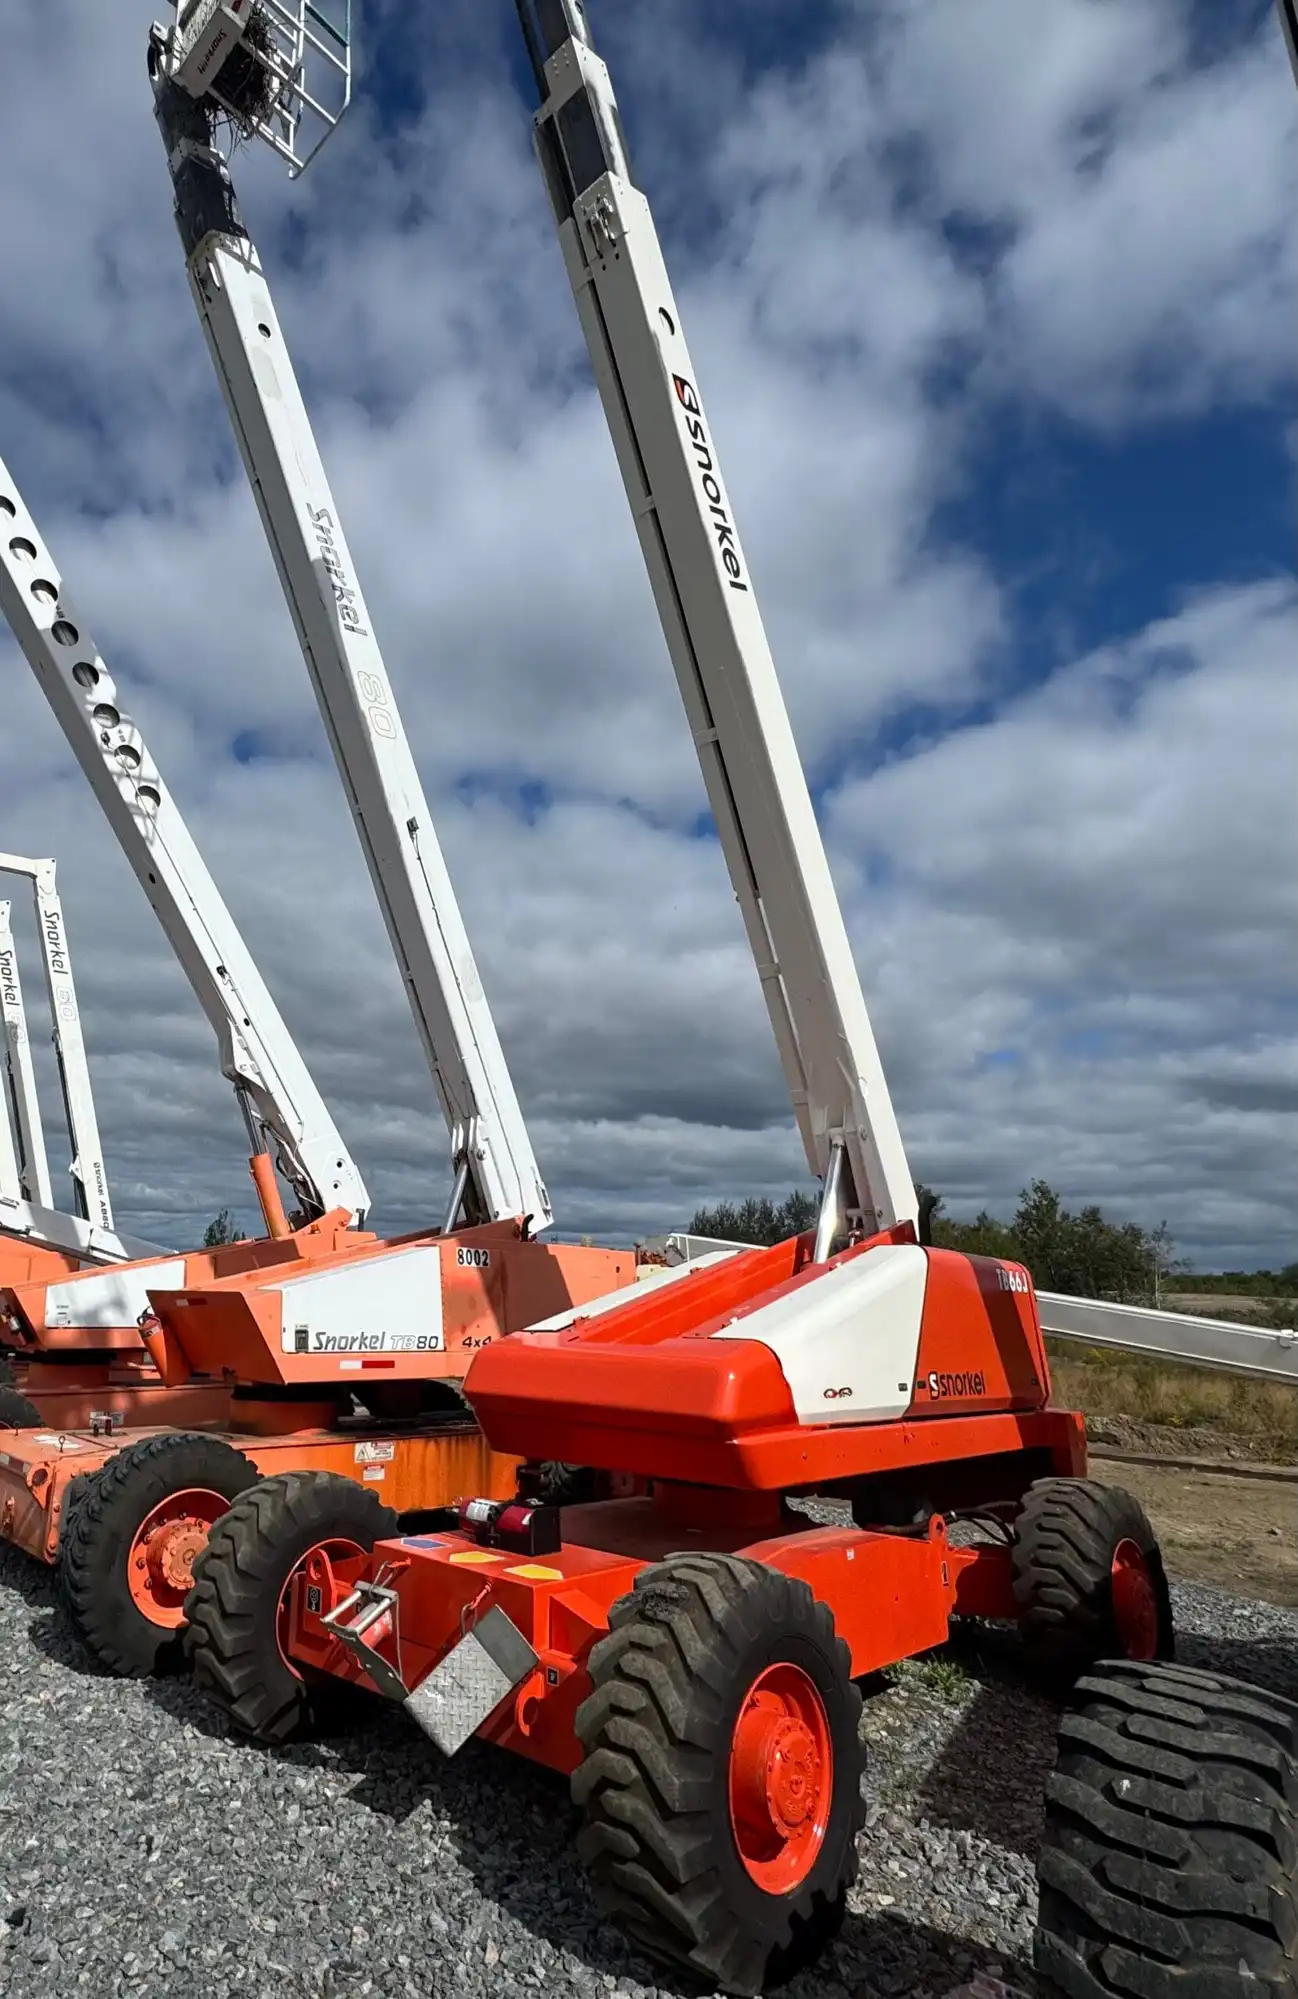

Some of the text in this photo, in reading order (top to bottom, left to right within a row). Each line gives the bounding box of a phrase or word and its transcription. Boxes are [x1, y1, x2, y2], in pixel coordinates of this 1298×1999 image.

[685, 415, 748, 591] snorkel
[306, 502, 397, 740] Snorkel 80
[44, 910, 68, 975] Snorkel
[0, 950, 20, 1006] Snorkel
[457, 1248, 489, 1266] 8002
[313, 1331, 439, 1350] Snorkel TB80
[462, 1336, 491, 1349] 4x4
[940, 1371, 986, 1396] snorkel
